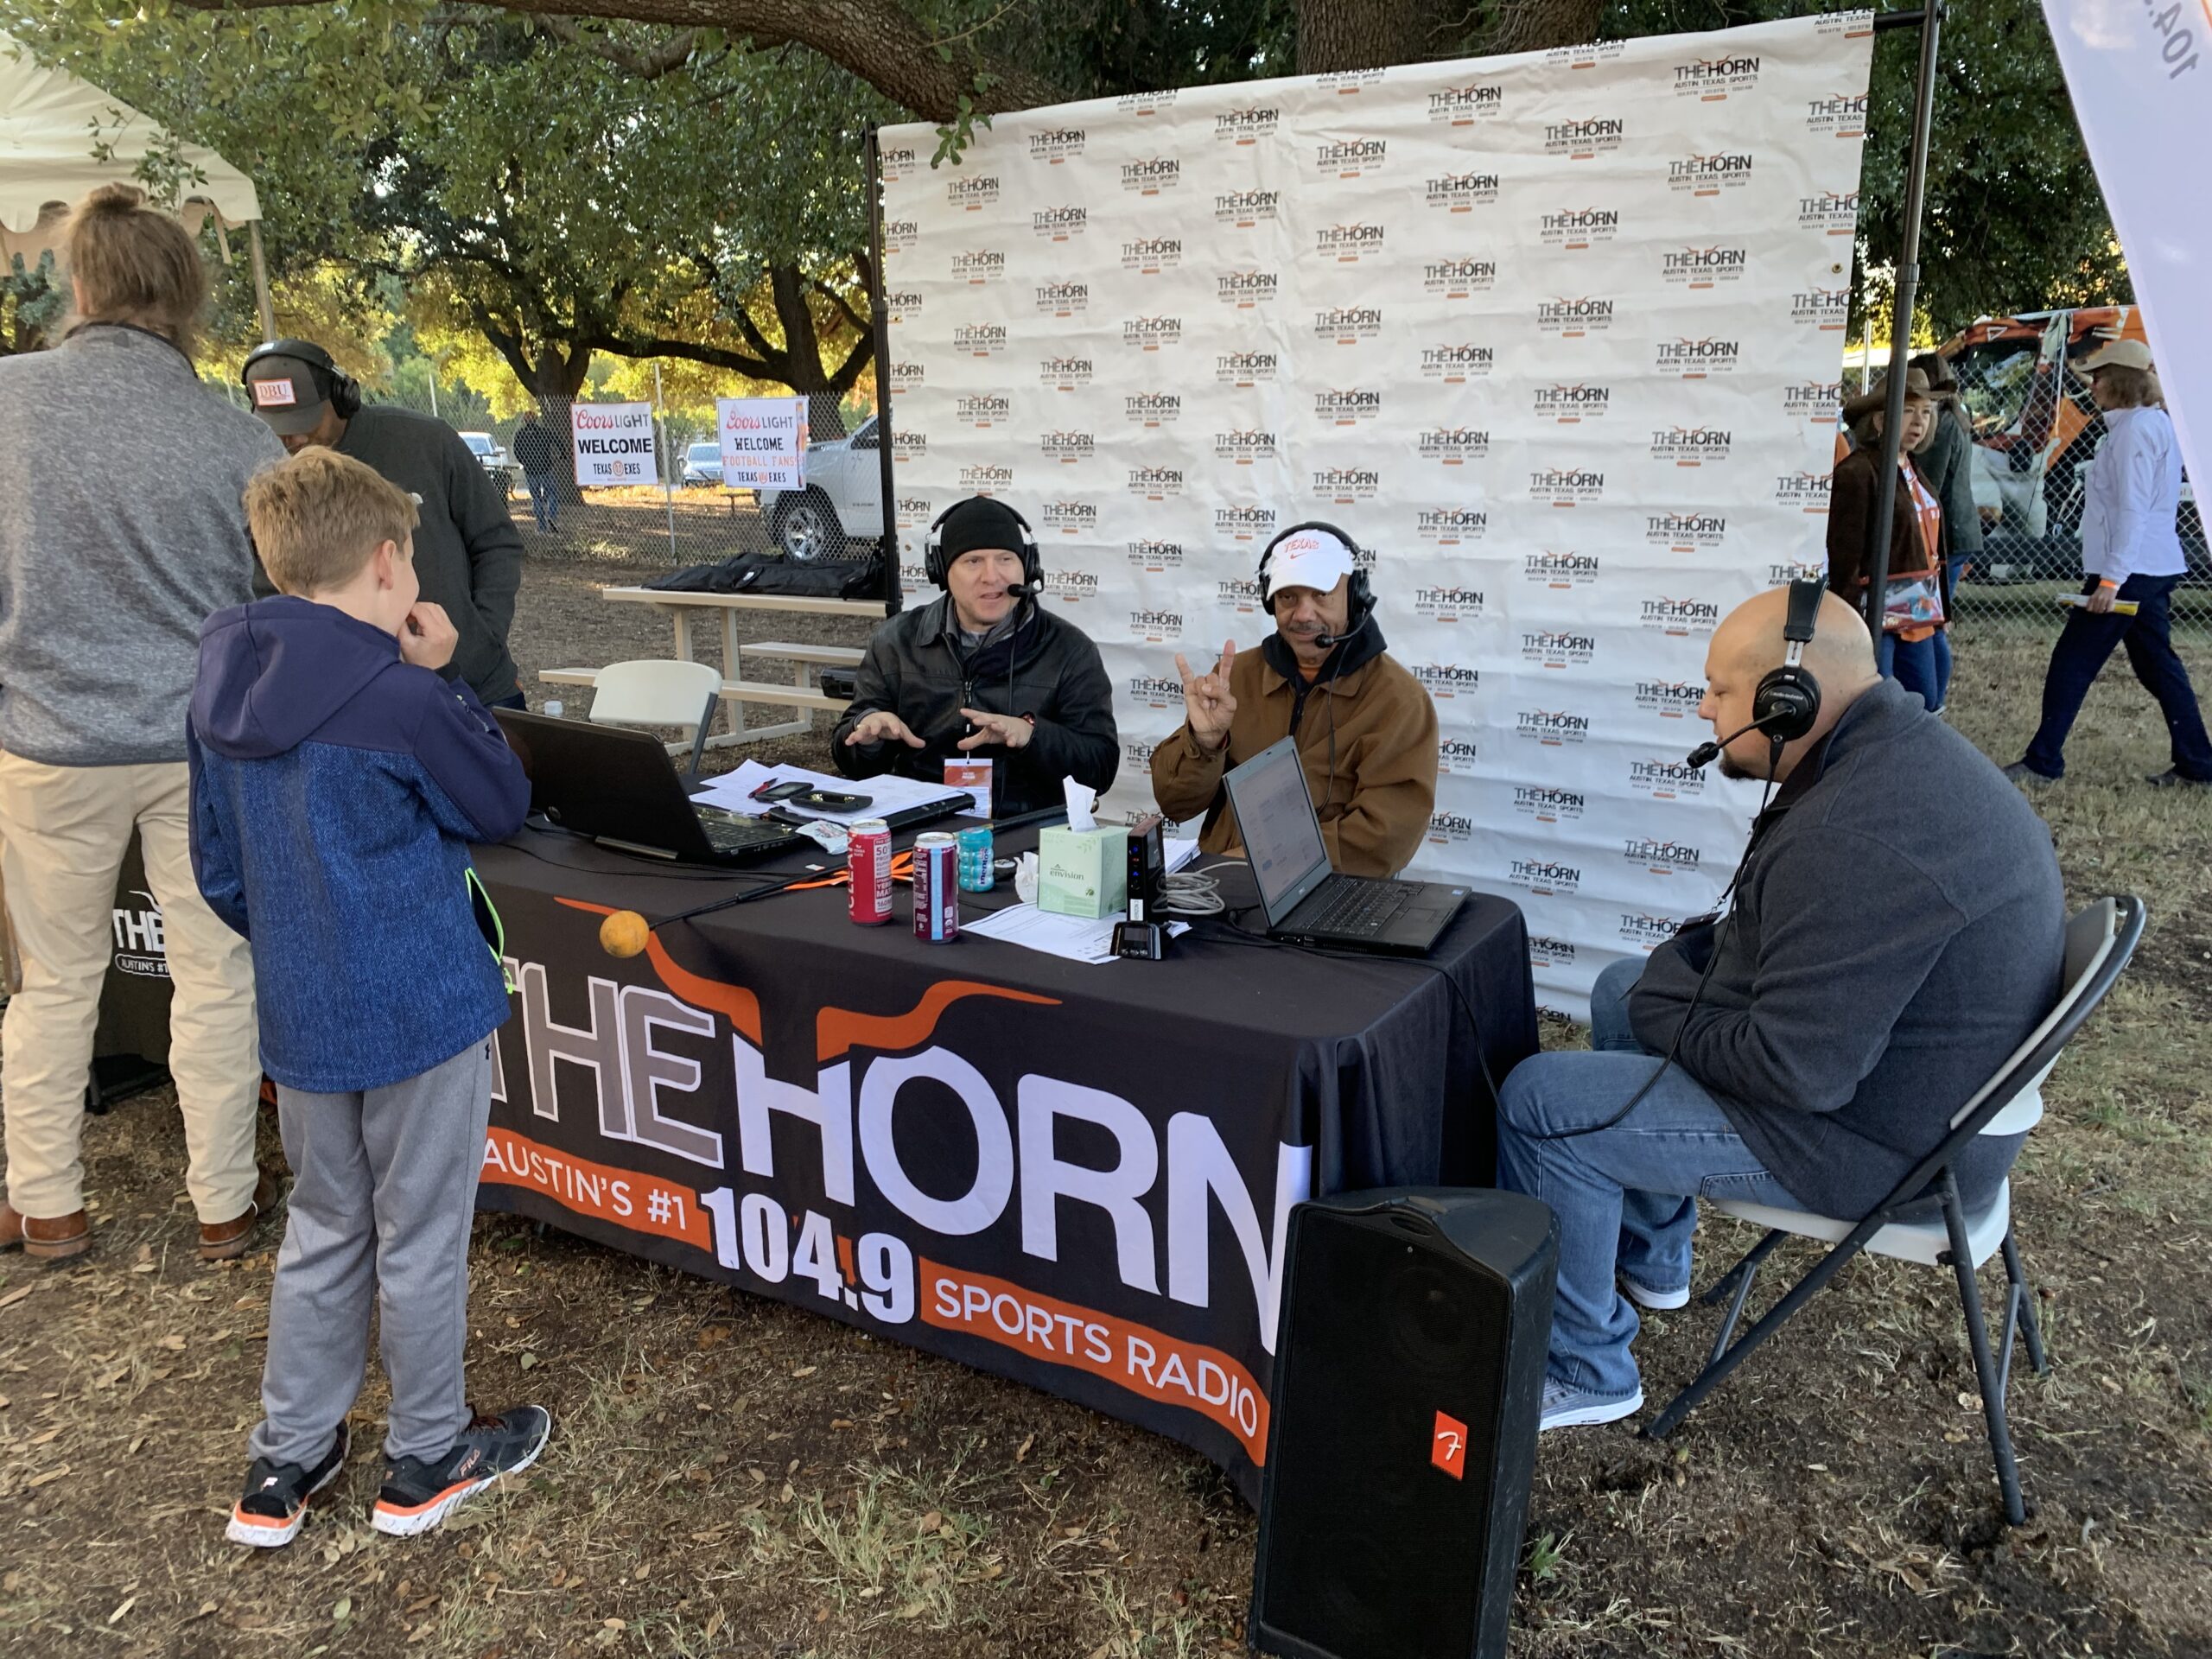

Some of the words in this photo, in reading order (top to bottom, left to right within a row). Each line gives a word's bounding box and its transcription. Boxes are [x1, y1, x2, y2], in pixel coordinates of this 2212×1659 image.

[883, 149, 915, 163] HORN
[886, 222, 918, 235] HORN
[889, 294, 922, 306] HORN
[892, 364, 924, 376] HORN
[260, 385, 288, 398] DBU
[575, 410, 613, 429] Coors
[615, 414, 649, 429] LIGHT
[726, 410, 761, 429] Coors
[762, 416, 793, 429] LIGHT
[578, 438, 653, 454] WELCOME
[734, 437, 784, 450] WELCOME
[894, 434, 926, 445] HORN
[722, 455, 768, 467] FOOTBALL
[594, 463, 613, 475] TEXAS
[625, 463, 641, 475] EXES
[738, 471, 758, 482] TEXAS
[768, 472, 786, 483] EXES
[899, 501, 931, 512] HORN
[1285, 537, 1319, 553] TEXAS
[1432, 815, 1471, 830] HORN
[980, 848, 988, 885] mentos
[1050, 870, 1084, 880] envision
[481, 1138, 632, 1217] AUSTIN'S
[647, 1187, 687, 1232] #1
[701, 1186, 915, 1324] 104.9
[935, 1278, 1113, 1363] SPORTS
[1127, 1337, 1257, 1438] RADIO
